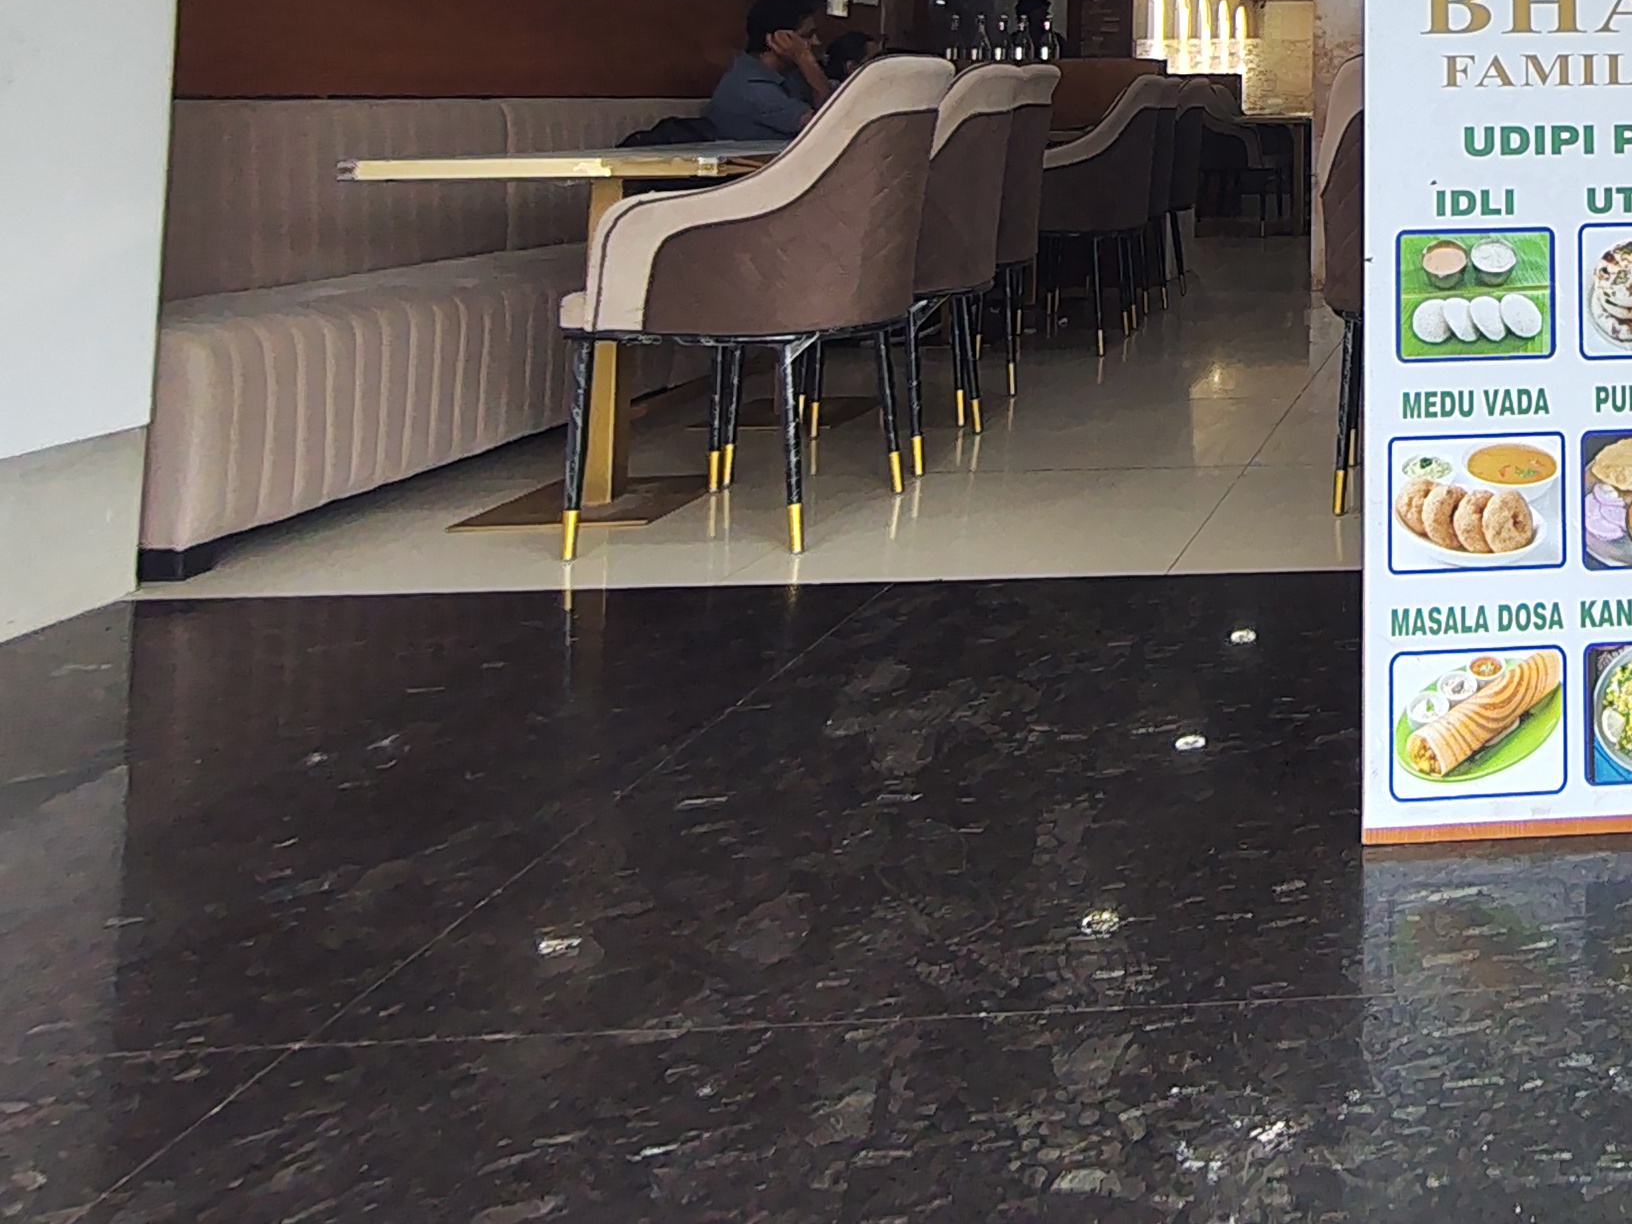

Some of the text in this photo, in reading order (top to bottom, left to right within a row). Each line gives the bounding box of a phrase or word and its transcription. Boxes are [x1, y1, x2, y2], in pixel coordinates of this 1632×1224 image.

[1463, 125, 1595, 157] UDIPI
[1435, 189, 1515, 217] IDLI
[1401, 388, 1550, 419] MEDU VADA
[1391, 602, 1564, 637] MASALA DOSA
